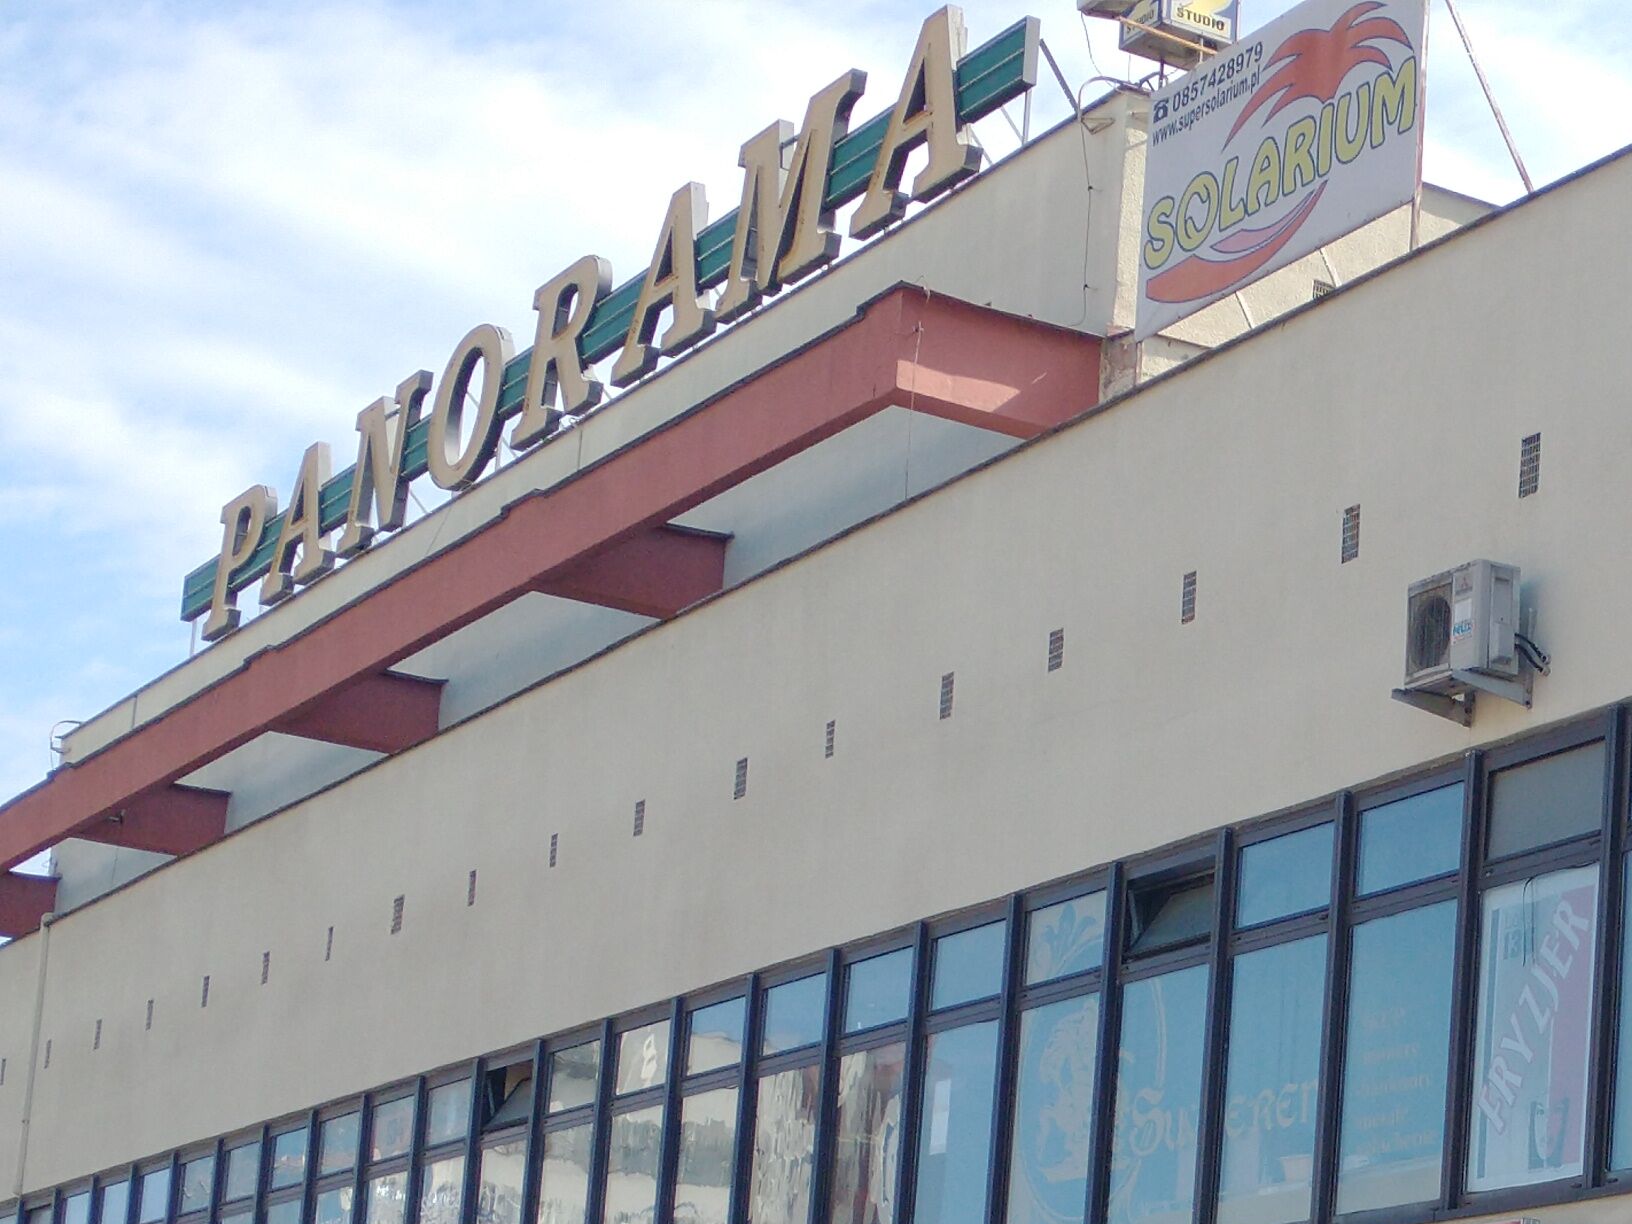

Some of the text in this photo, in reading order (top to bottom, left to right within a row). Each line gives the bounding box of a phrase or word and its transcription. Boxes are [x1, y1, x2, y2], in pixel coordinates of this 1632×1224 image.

[1173, 42, 1263, 113] 0857428979
[1177, 7, 1225, 31] STUDIO
[1143, 55, 1417, 270] SOLARIUM
[1152, 64, 1261, 147] www.supersolarium.pl
[201, 4, 984, 642] PANORAMA
[1478, 899, 1591, 1138] FRYZJER
